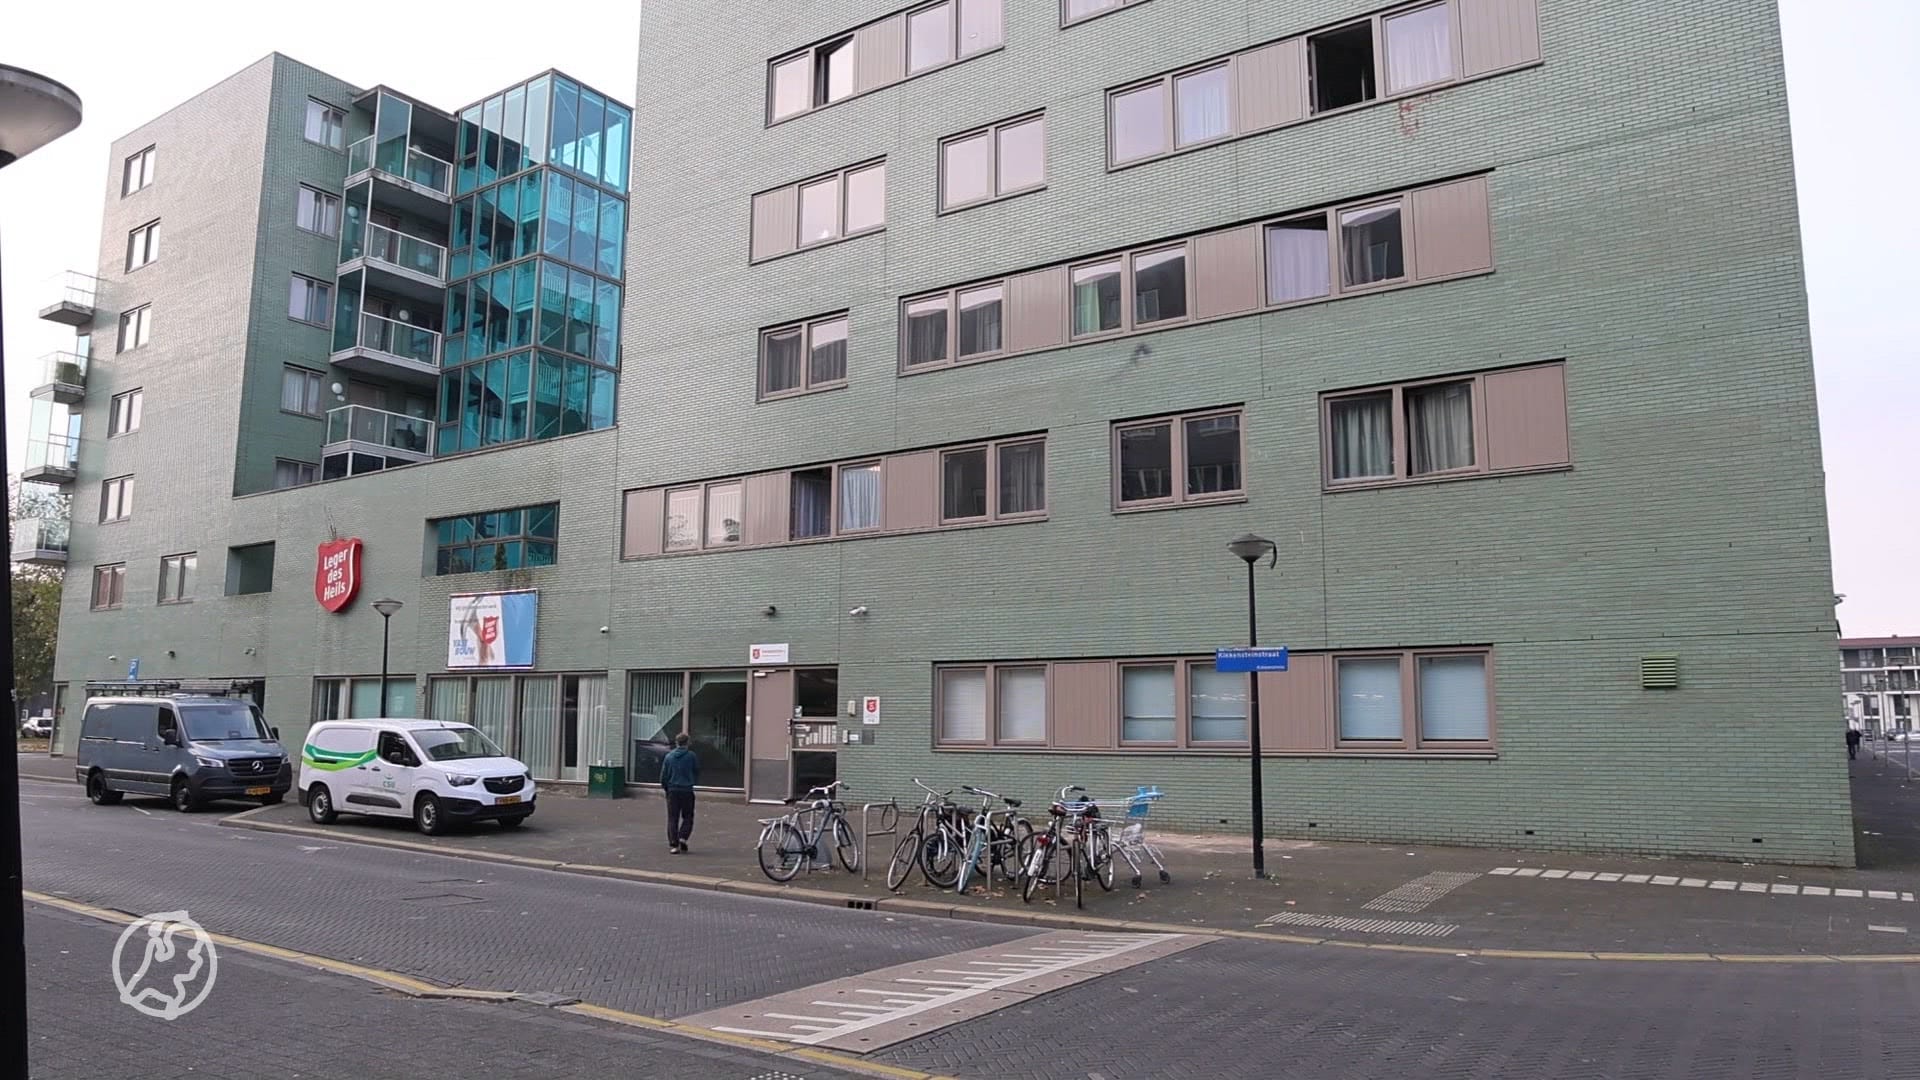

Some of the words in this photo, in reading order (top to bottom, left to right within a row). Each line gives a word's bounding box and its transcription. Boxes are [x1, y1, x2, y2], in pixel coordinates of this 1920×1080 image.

[324, 549, 348, 570] Leger
[328, 568, 343, 583] des
[324, 581, 346, 601] Heils
